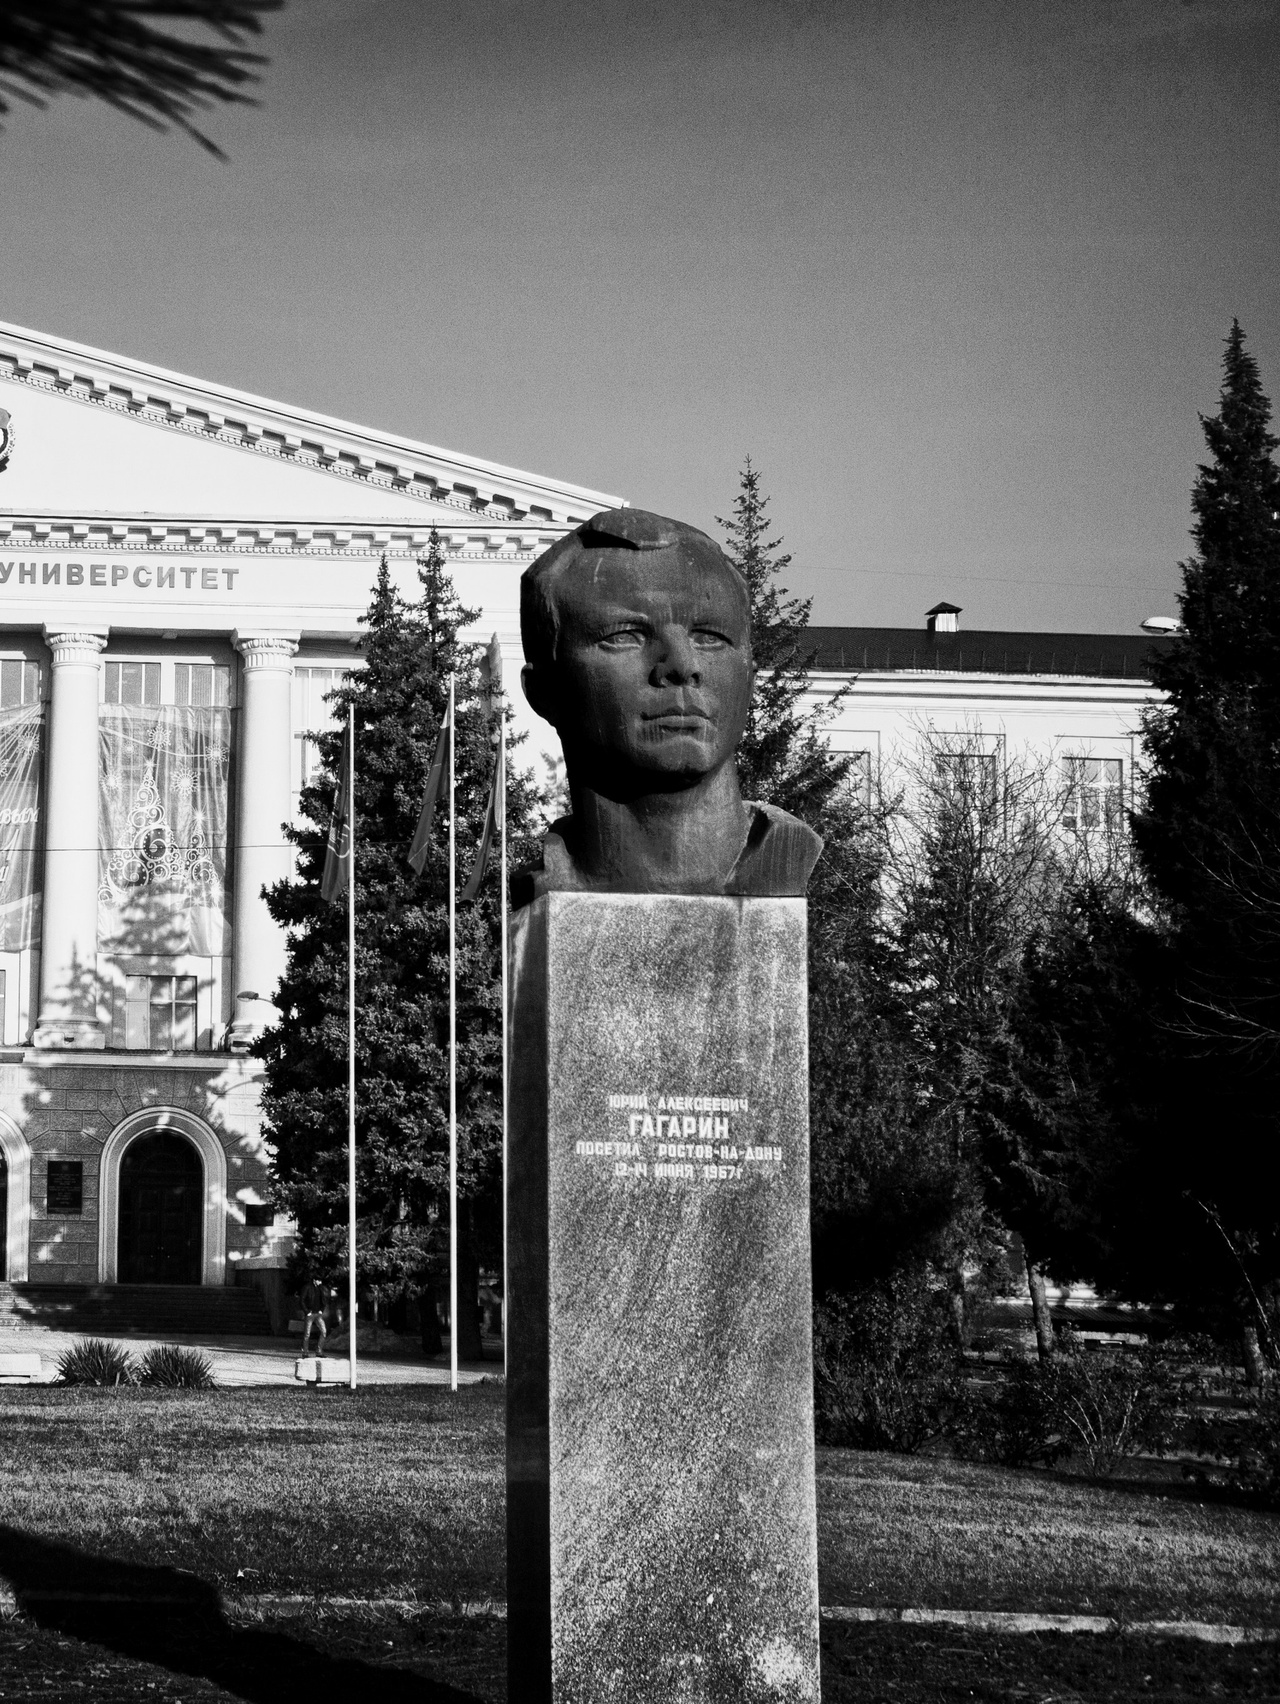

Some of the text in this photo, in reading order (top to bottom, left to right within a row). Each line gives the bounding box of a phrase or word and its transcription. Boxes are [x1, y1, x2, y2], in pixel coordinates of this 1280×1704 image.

[609, 1094, 748, 1112] ЮРИЙ АЛЕКСЕЕВИЧ
[630, 1115, 729, 1139] ГАГАРИН
[576, 1141, 782, 1161] ПОСЕТИЛ РОСТОВ-НА-ДОНУ
[615, 1163, 648, 1178] 12-14
[655, 1163, 693, 1178] ИЮНЯ
